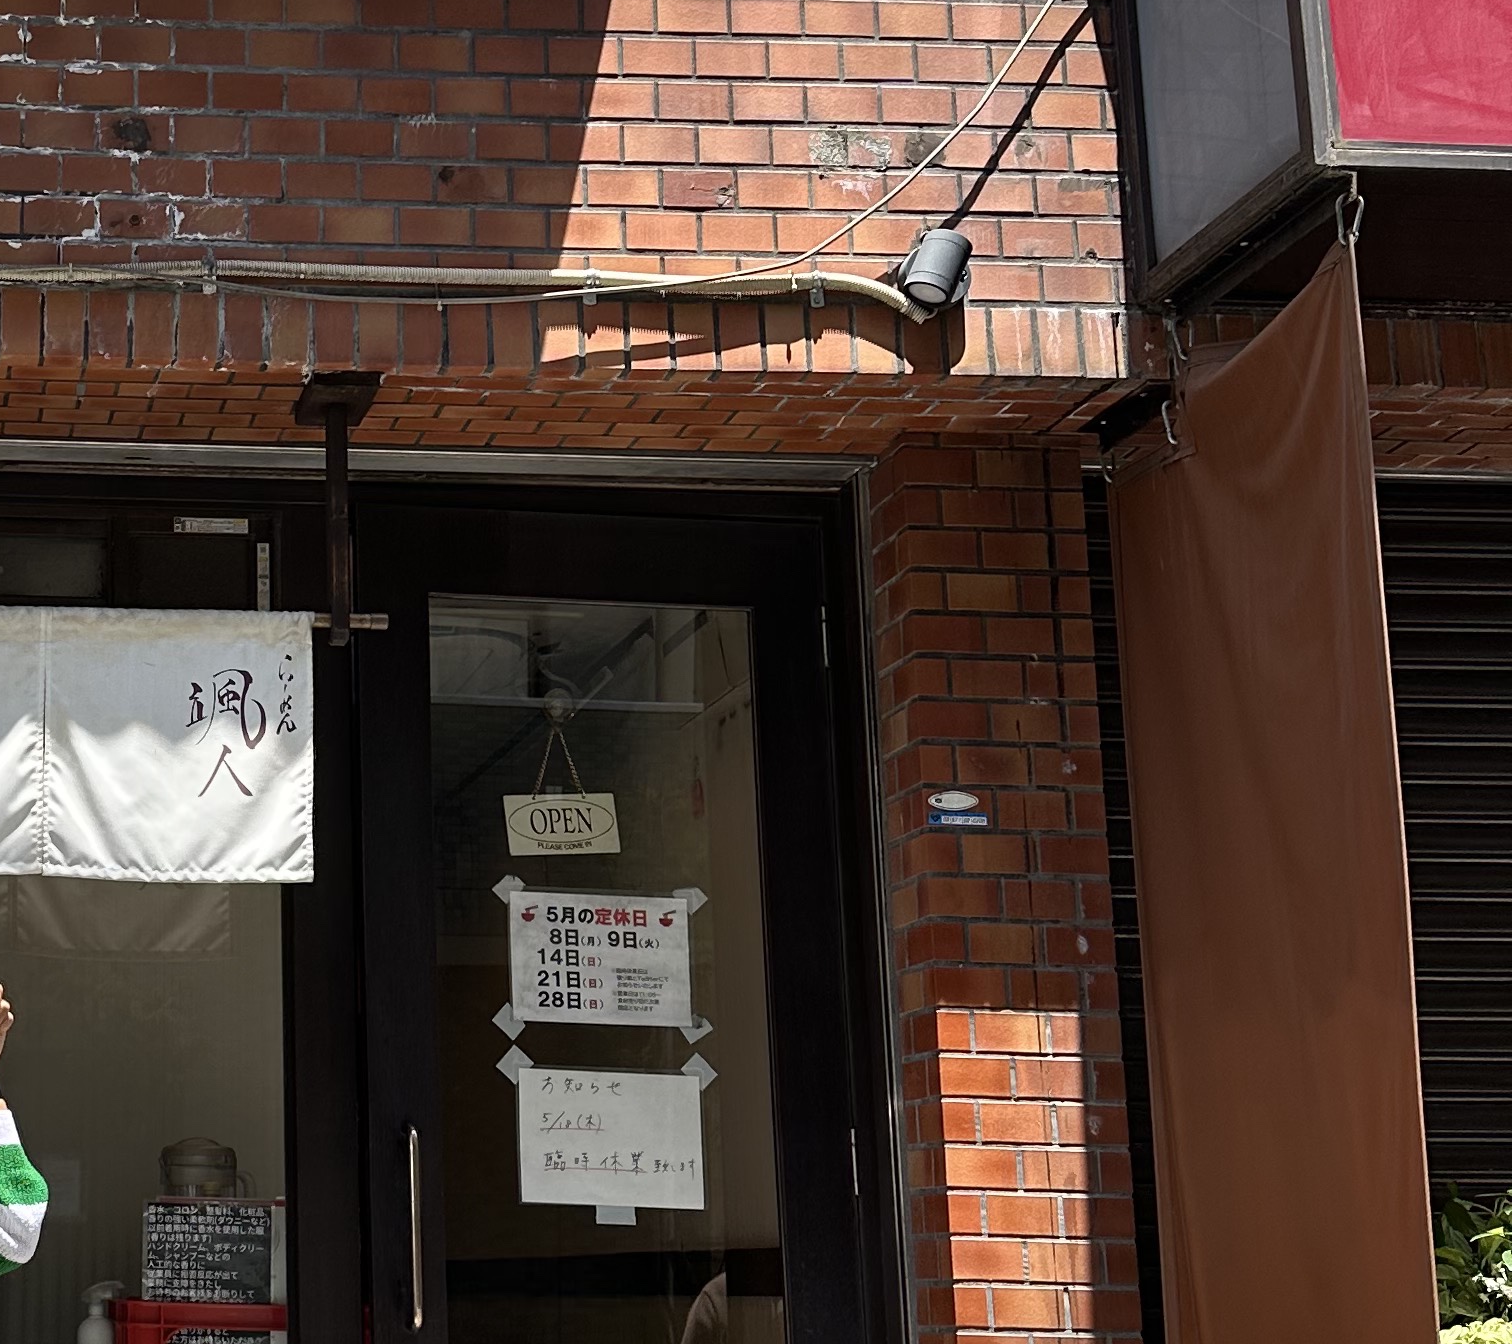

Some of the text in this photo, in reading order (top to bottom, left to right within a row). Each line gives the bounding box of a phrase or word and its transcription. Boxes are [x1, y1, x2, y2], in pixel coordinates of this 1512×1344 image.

[530, 807, 593, 835] OPEN
[537, 841, 563, 851] PLEASE
[563, 841, 585, 850] COME
[546, 906, 648, 928] 5月の定休日
